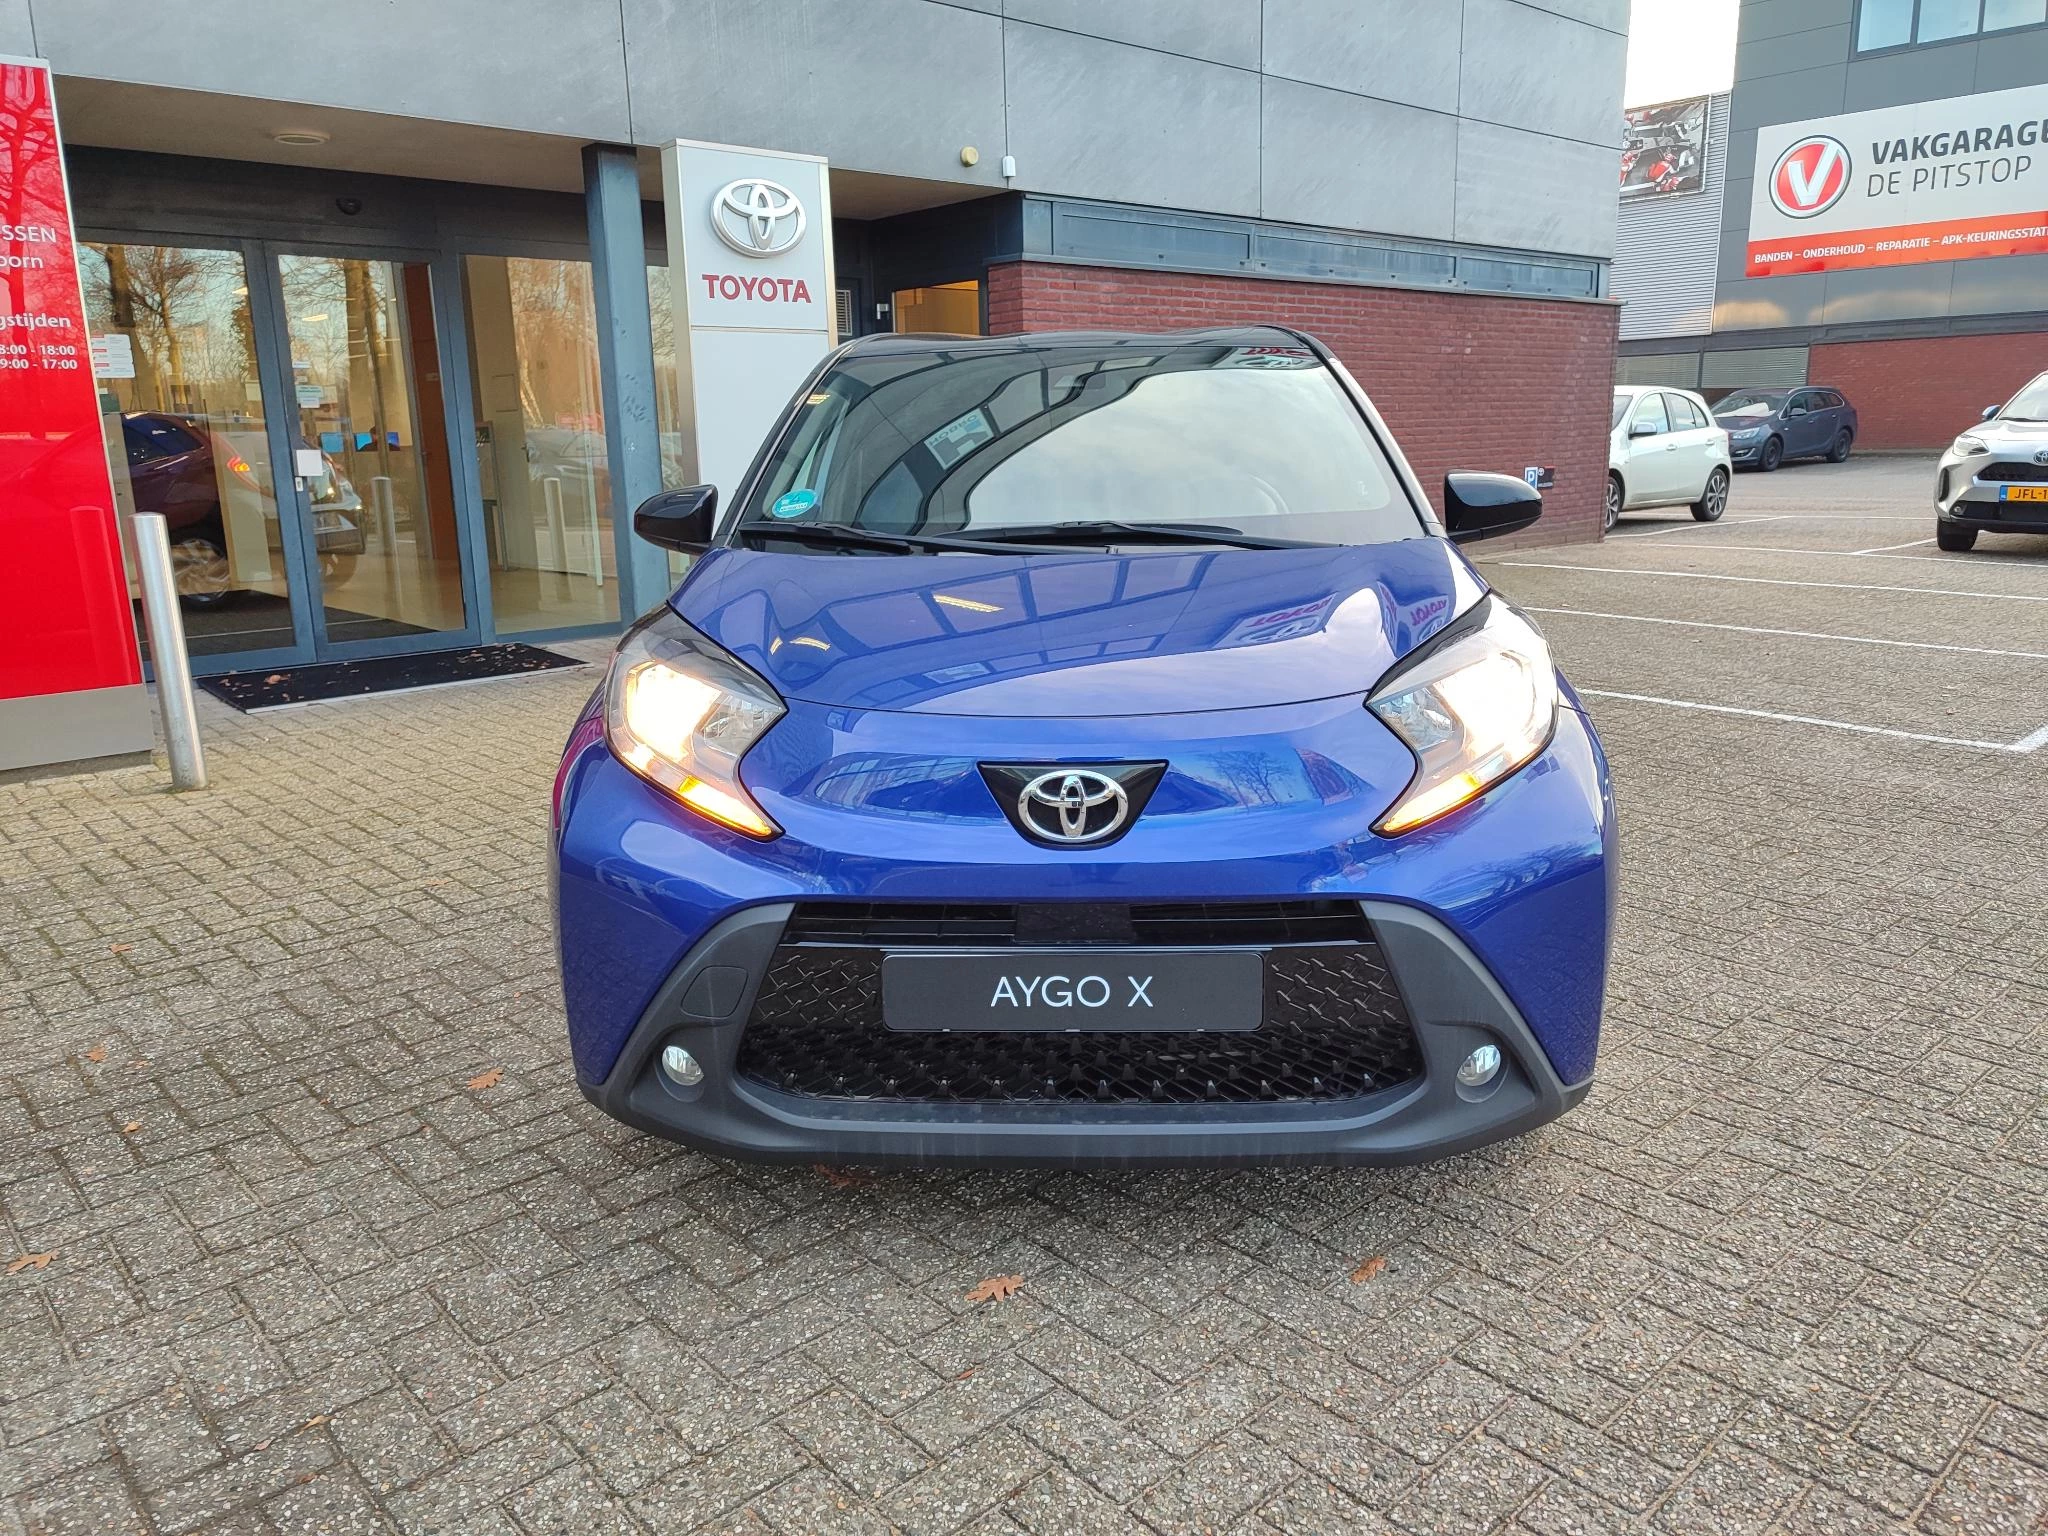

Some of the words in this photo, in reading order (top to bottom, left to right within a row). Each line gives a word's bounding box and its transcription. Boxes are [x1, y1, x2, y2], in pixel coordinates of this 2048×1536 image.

[1867, 171, 1901, 197] DE
[1913, 155, 2032, 192] PITSTOP
[1754, 250, 1793, 263] BANDEN
[1803, 243, 1865, 259] ONDERHOUD
[1876, 237, 1931, 251] REPARATIE
[701, 274, 812, 304] TOYOTA
[40, 345, 76, 356] 18:00
[41, 359, 78, 370] 17:00
[990, 976, 1110, 1008] AYGO
[1127, 976, 1154, 1007] X
